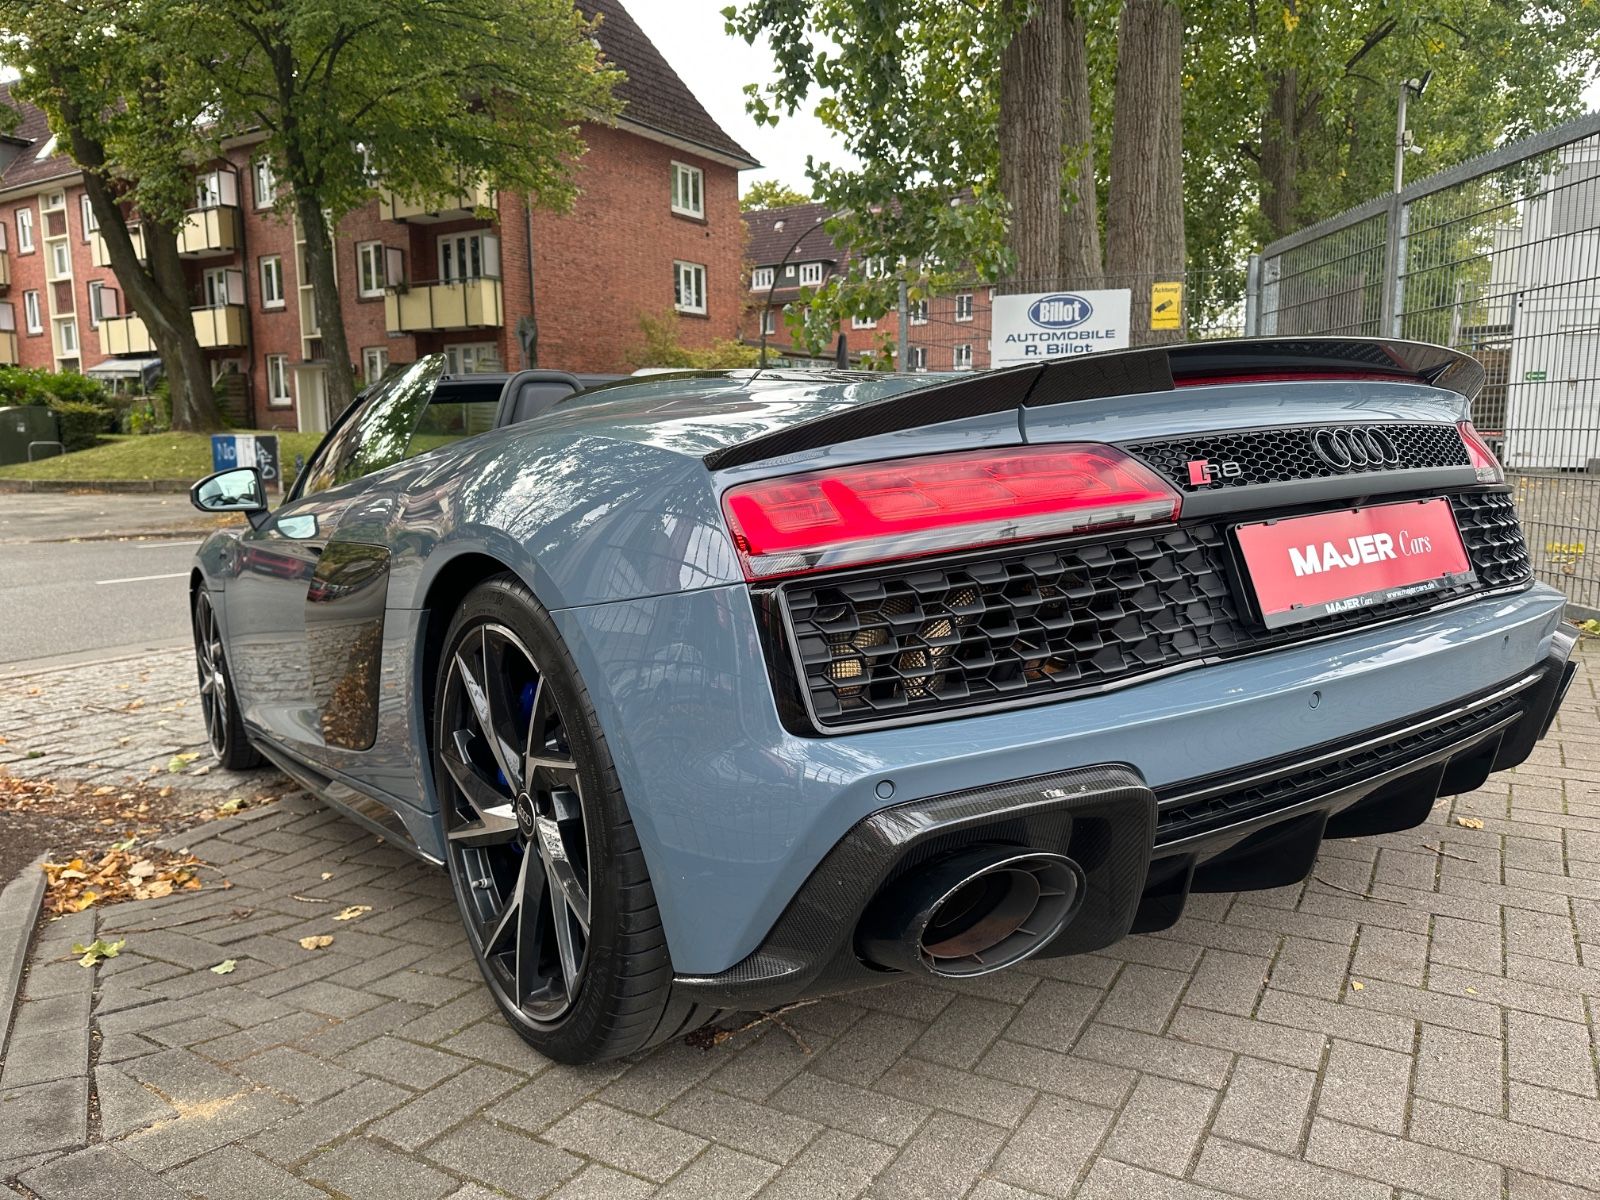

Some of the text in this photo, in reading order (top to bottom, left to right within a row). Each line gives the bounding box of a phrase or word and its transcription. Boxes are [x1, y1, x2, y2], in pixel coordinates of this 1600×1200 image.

[1039, 299, 1081, 323] Billot
[1005, 329, 1116, 343] AUTOMOBILE
[1025, 343, 1093, 356] R. Billot
[1202, 461, 1241, 480] R8
[1288, 530, 1432, 577] MAJER Cars
[1325, 582, 1435, 614] MAJER Cars www.majercars.de
